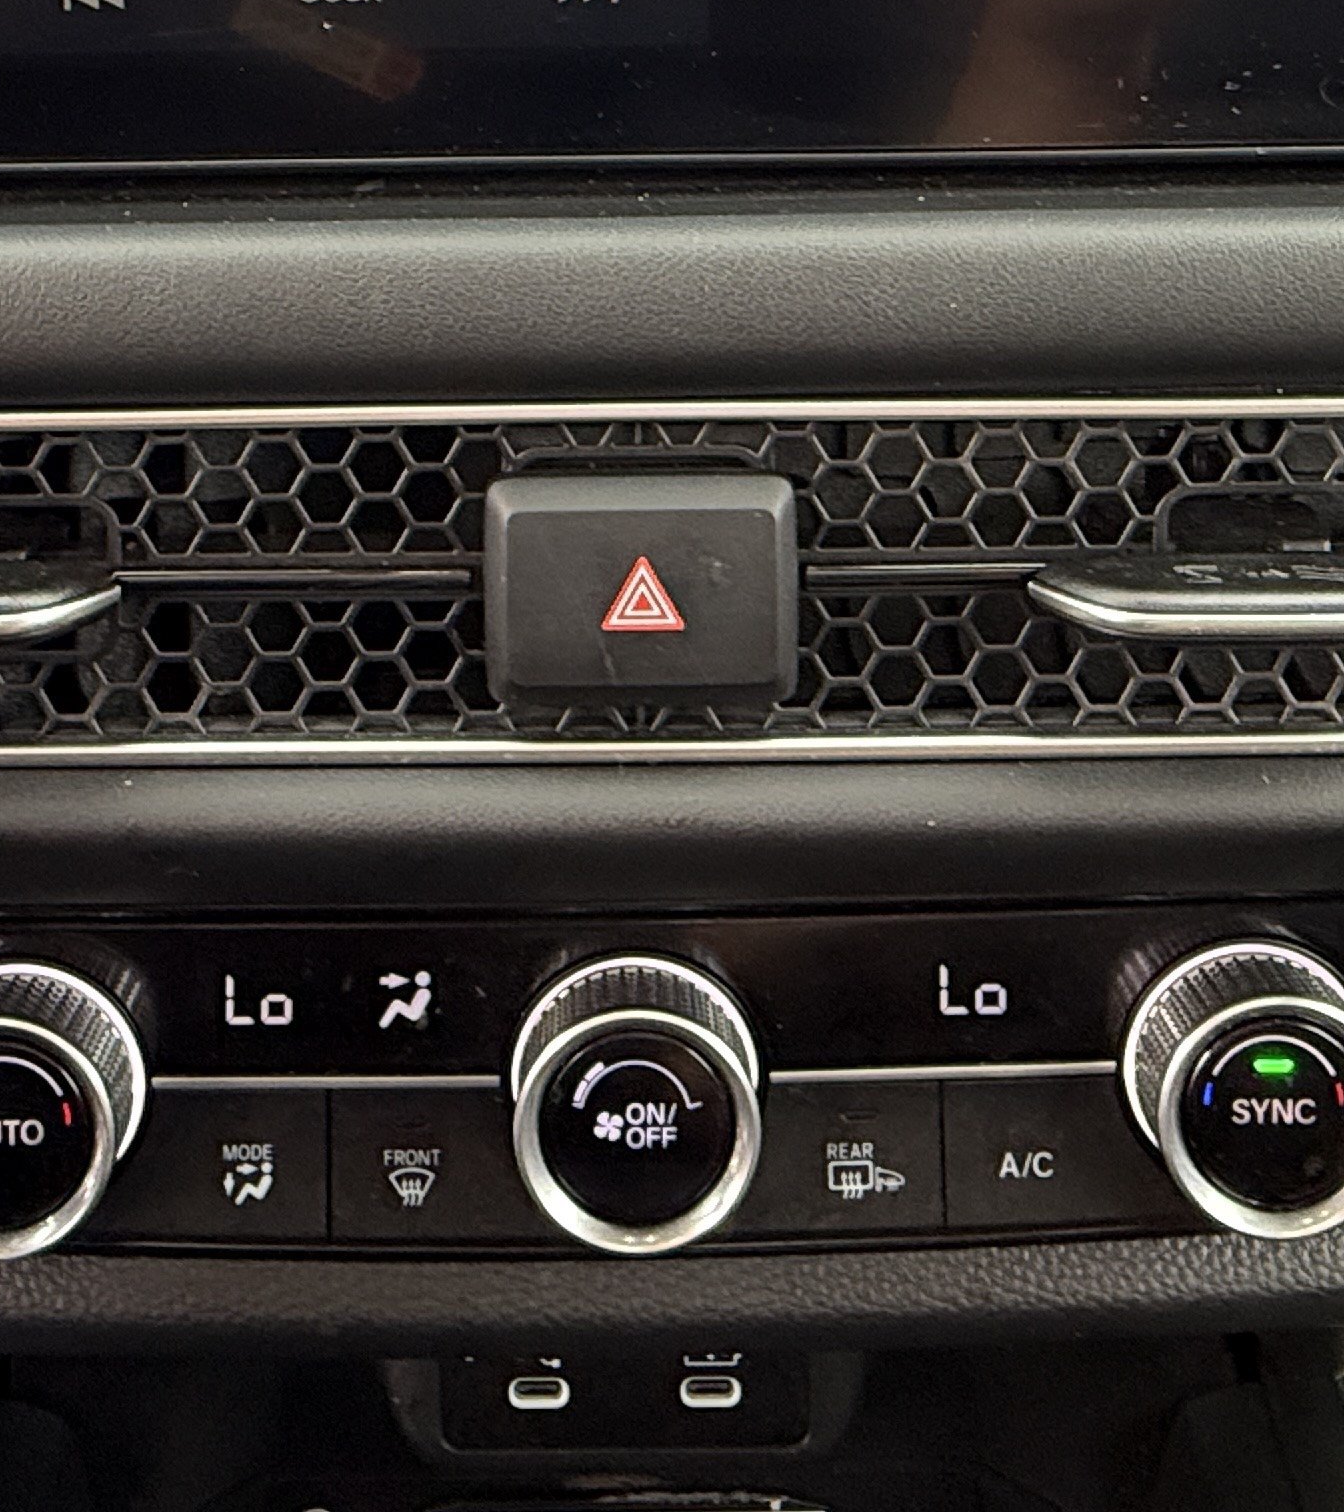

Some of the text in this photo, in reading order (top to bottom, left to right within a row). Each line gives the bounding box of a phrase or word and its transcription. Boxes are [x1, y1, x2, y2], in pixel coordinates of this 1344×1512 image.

[625, 1102, 677, 1126] ON/
[1232, 1098, 1316, 1124] SYNC
[626, 1126, 677, 1150] OFF
[222, 1143, 272, 1163] MODE
[383, 1148, 440, 1168] FRONT
[826, 1142, 874, 1160] REAR
[999, 1151, 1054, 1178] A/C
